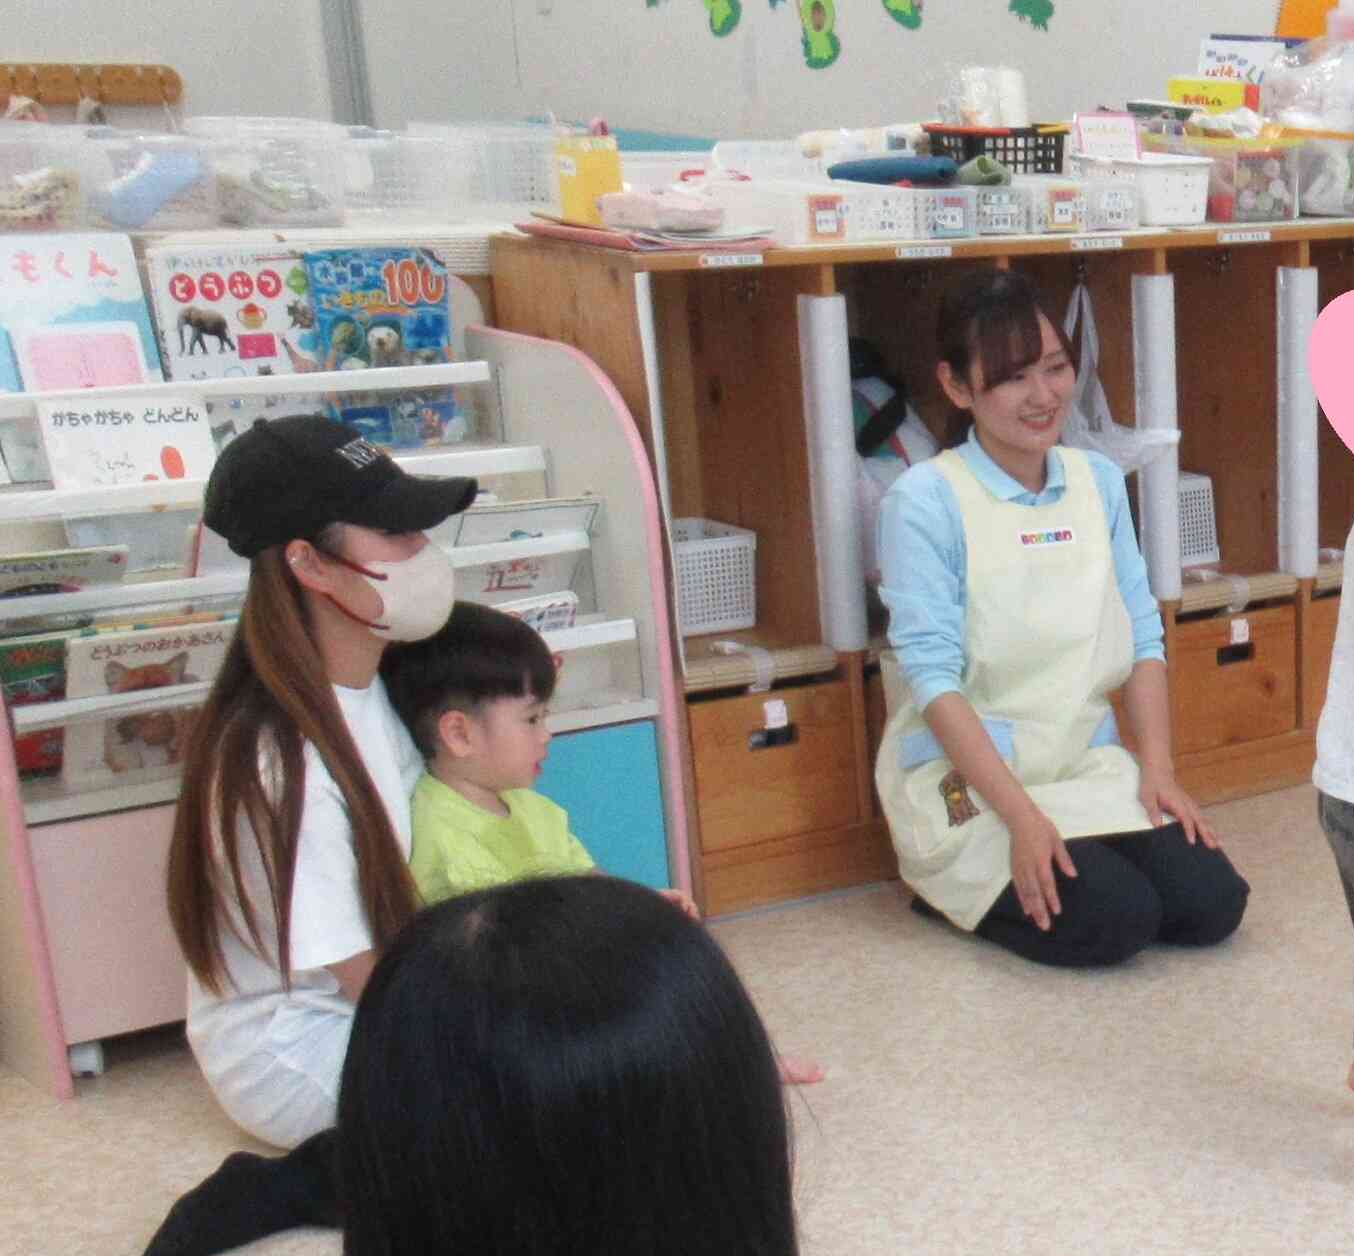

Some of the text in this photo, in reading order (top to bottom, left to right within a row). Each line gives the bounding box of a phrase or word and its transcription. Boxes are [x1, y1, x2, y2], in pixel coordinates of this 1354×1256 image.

[0, 249, 118, 283] もくん
[383, 258, 446, 305] 100
[172, 270, 281, 302] どうぶつ
[52, 406, 199, 427] がちゃがちゃ どんどん
[91, 631, 224, 660] どうぶつのおかあさん
